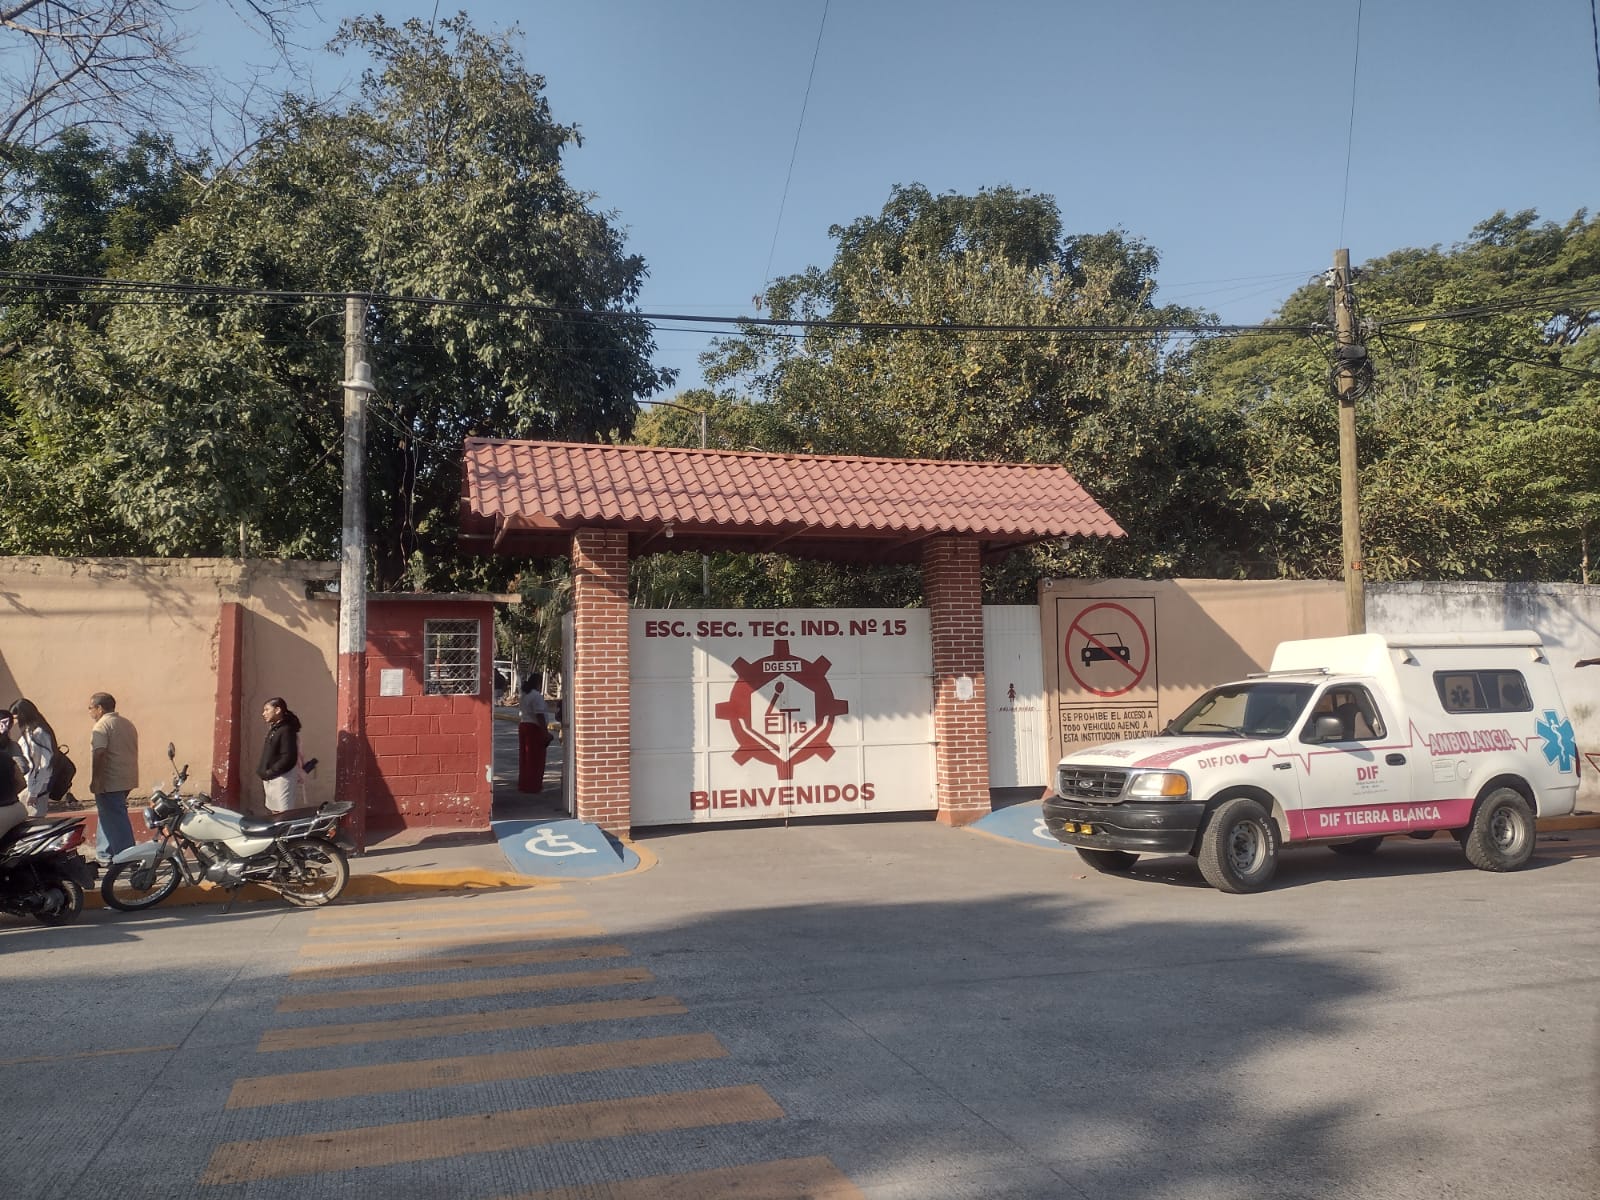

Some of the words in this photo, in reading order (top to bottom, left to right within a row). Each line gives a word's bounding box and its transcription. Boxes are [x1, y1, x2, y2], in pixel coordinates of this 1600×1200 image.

[645, 620, 691, 637] ESC.
[697, 620, 743, 637] SEC.
[749, 620, 795, 637] TEC.
[801, 619, 844, 636] IND.
[882, 619, 907, 636] 15
[764, 662, 799, 672] DGEST
[1062, 712, 1071, 721] SE
[1074, 711, 1108, 721] PROHIBE
[1111, 711, 1121, 720] EL
[1123, 710, 1146, 719] ACCESO
[1147, 710, 1153, 719] A
[1063, 723, 1081, 732] TODO
[1083, 722, 1116, 731] VEHICULO
[1118, 721, 1140, 730] AJENO
[1142, 720, 1149, 729] A
[1063, 733, 1079, 743] ESTA
[1429, 729, 1516, 756] AMBULANCIA
[1357, 765, 1379, 781] DIF
[690, 782, 876, 811] BIENVENIDOS
[1320, 813, 1341, 827] DIF
[1344, 809, 1390, 825] TIERRA
[1392, 806, 1441, 822] BLANCA
